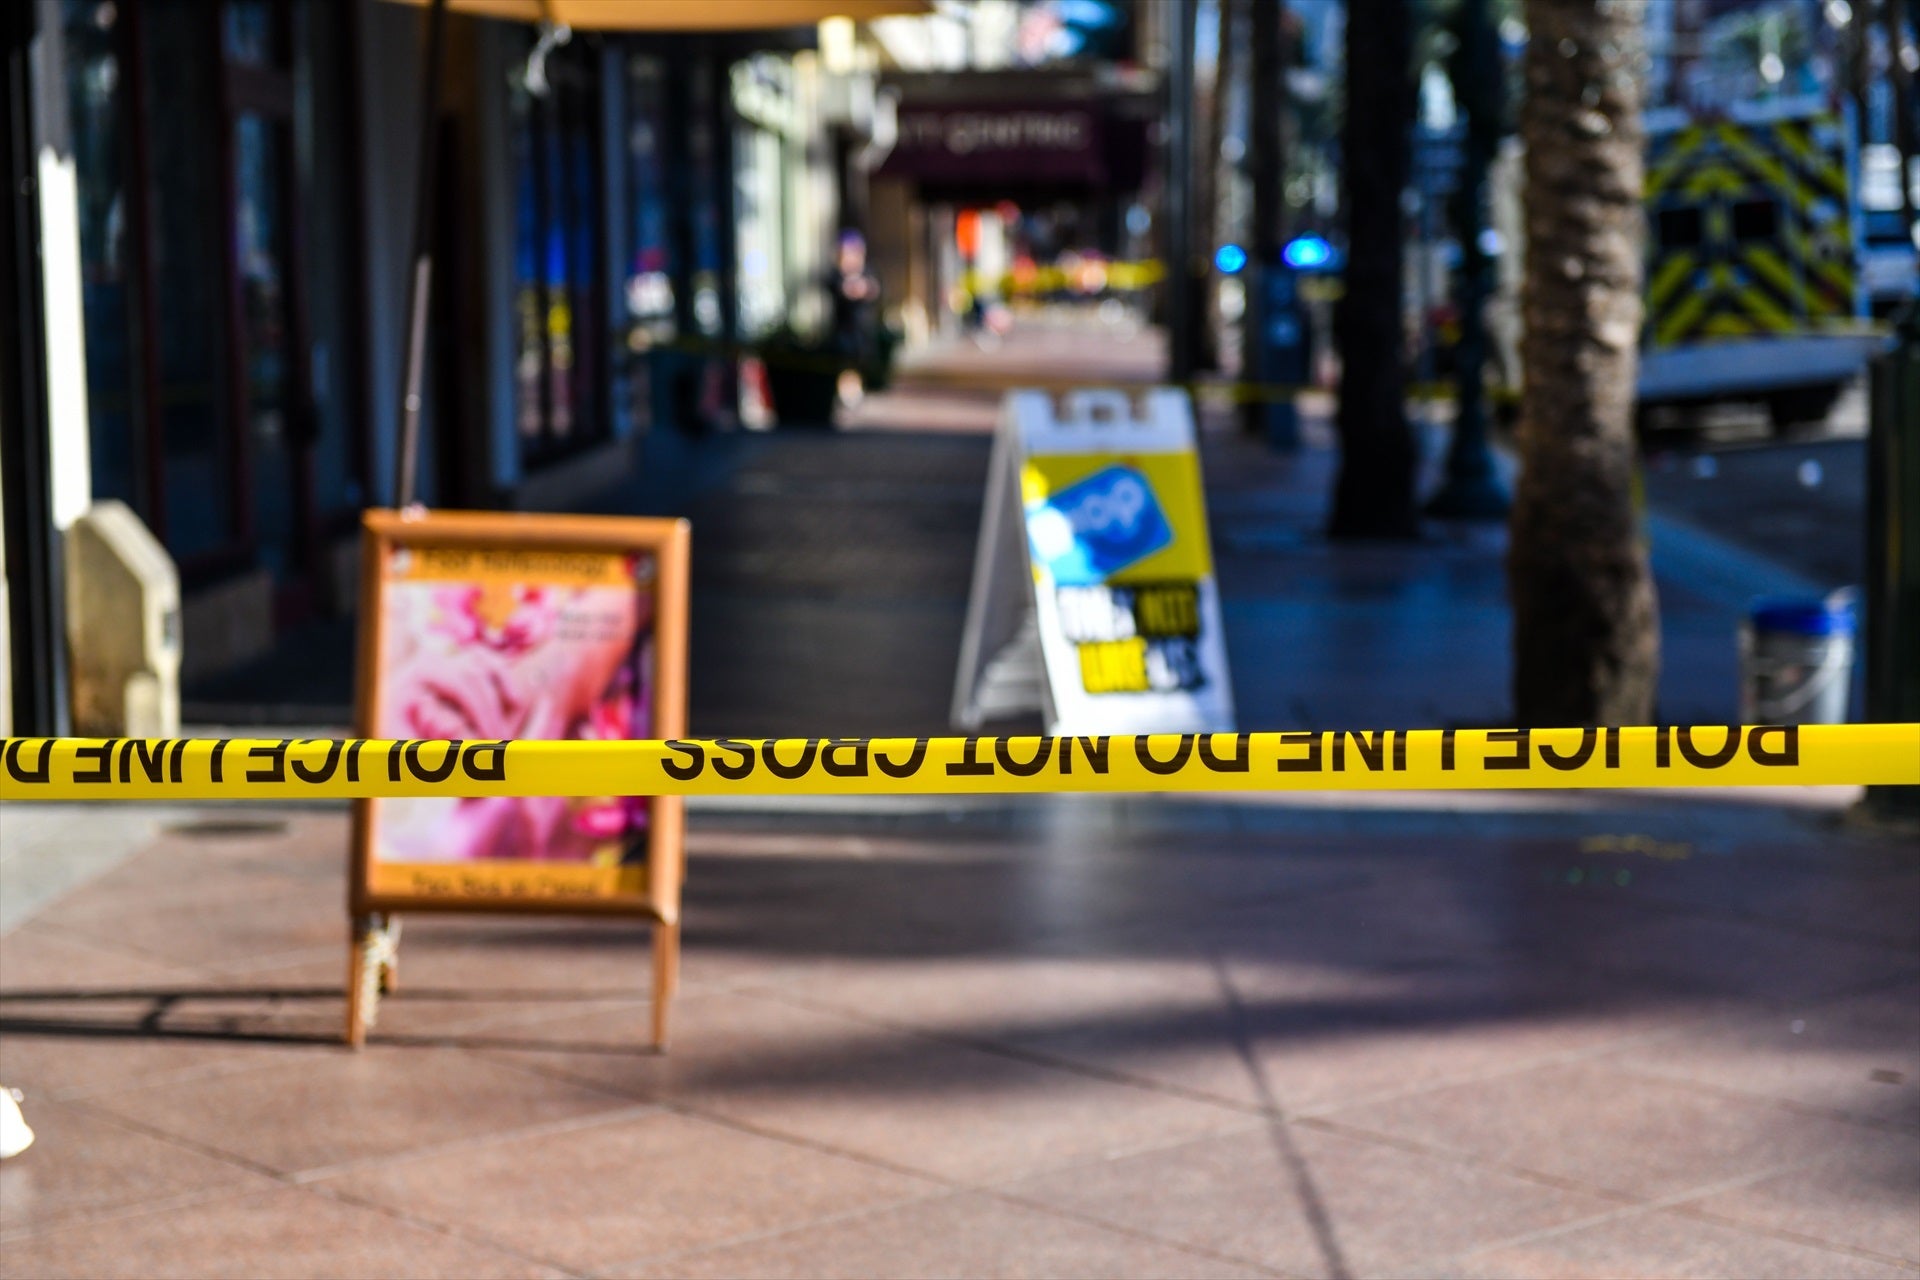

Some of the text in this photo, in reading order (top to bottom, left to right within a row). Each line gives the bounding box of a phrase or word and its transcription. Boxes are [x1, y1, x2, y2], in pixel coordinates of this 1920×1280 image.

[0, 739, 55, 783] D
[661, 738, 930, 781] CROSS
[945, 735, 1110, 777] NOT
[1134, 733, 1250, 776] DO
